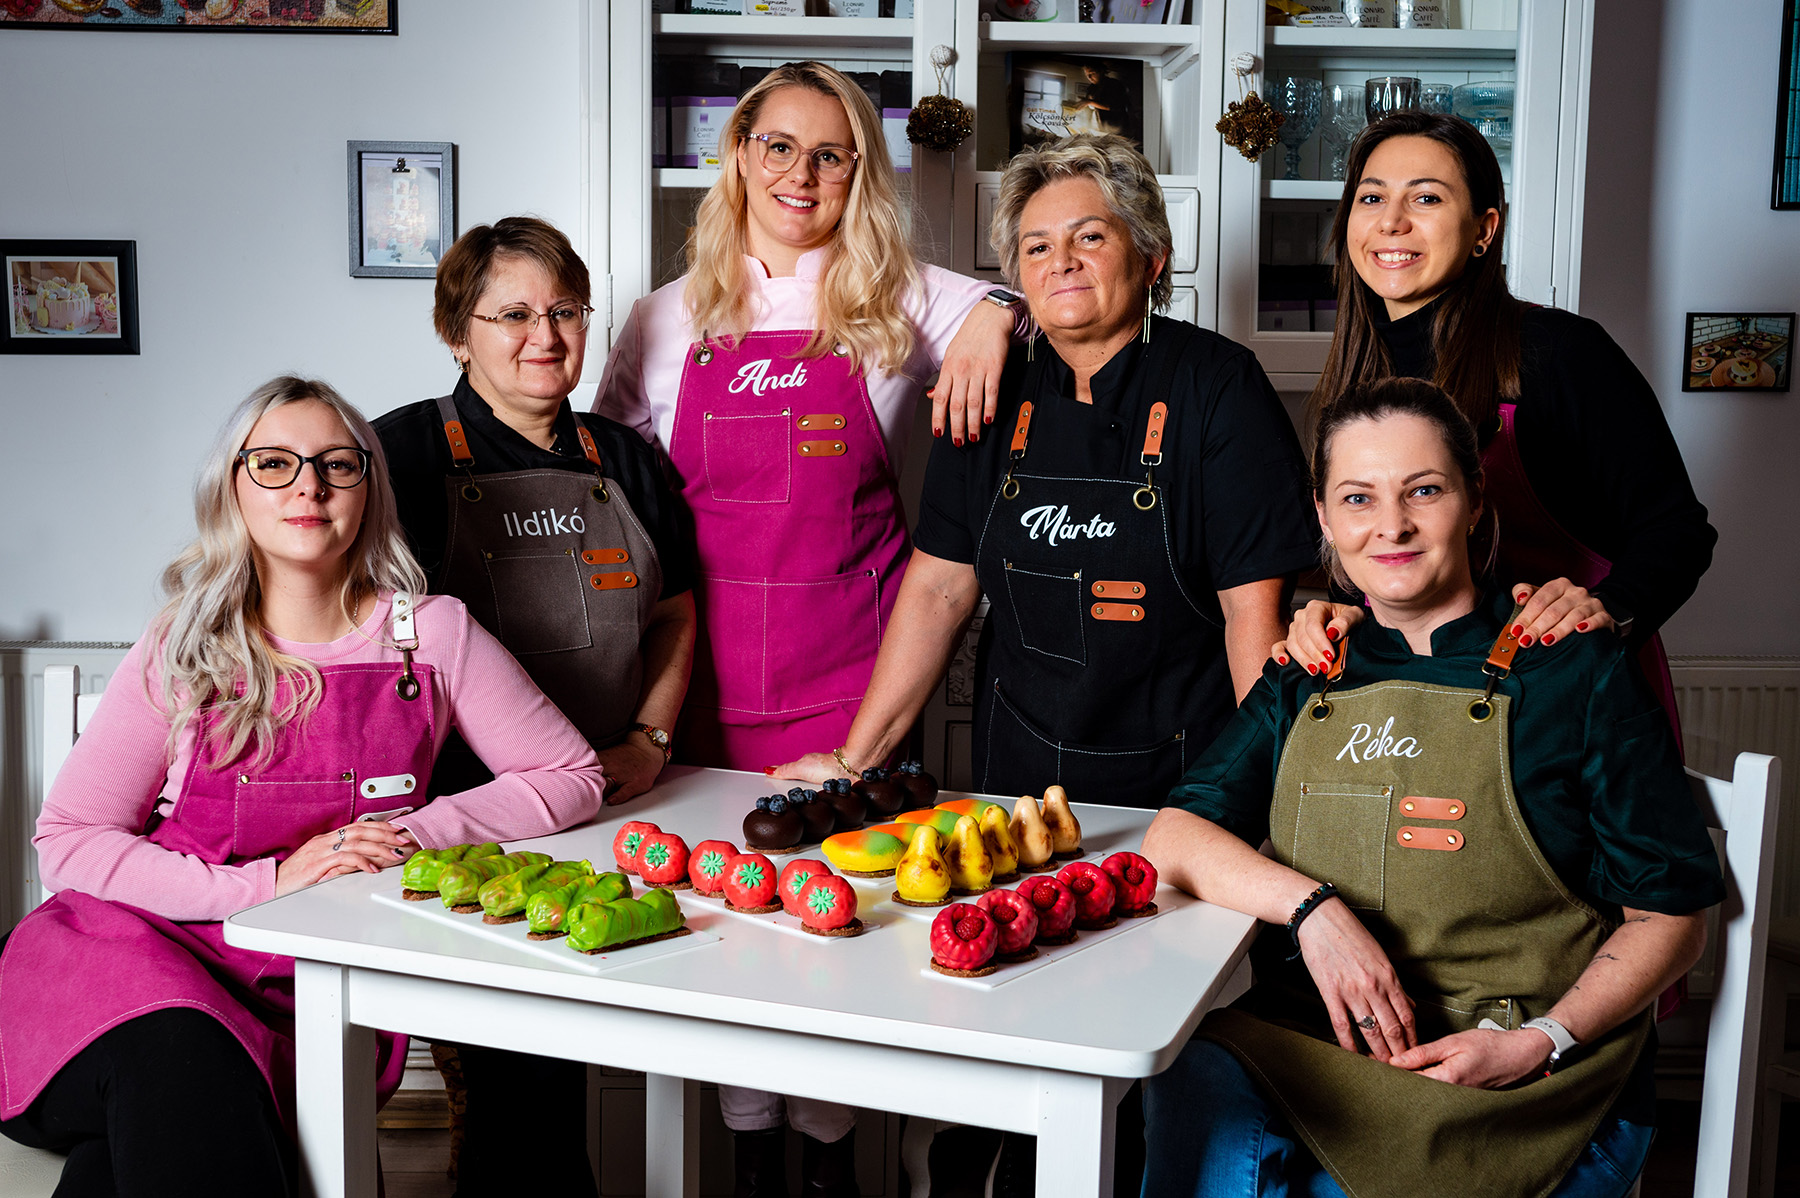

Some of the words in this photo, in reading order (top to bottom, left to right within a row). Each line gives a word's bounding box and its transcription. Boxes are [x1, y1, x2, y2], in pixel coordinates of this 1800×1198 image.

[728, 359, 808, 397] Andi
[503, 507, 586, 537] Ildikó
[1020, 504, 1116, 547] Márta
[1335, 716, 1423, 764] Réka
